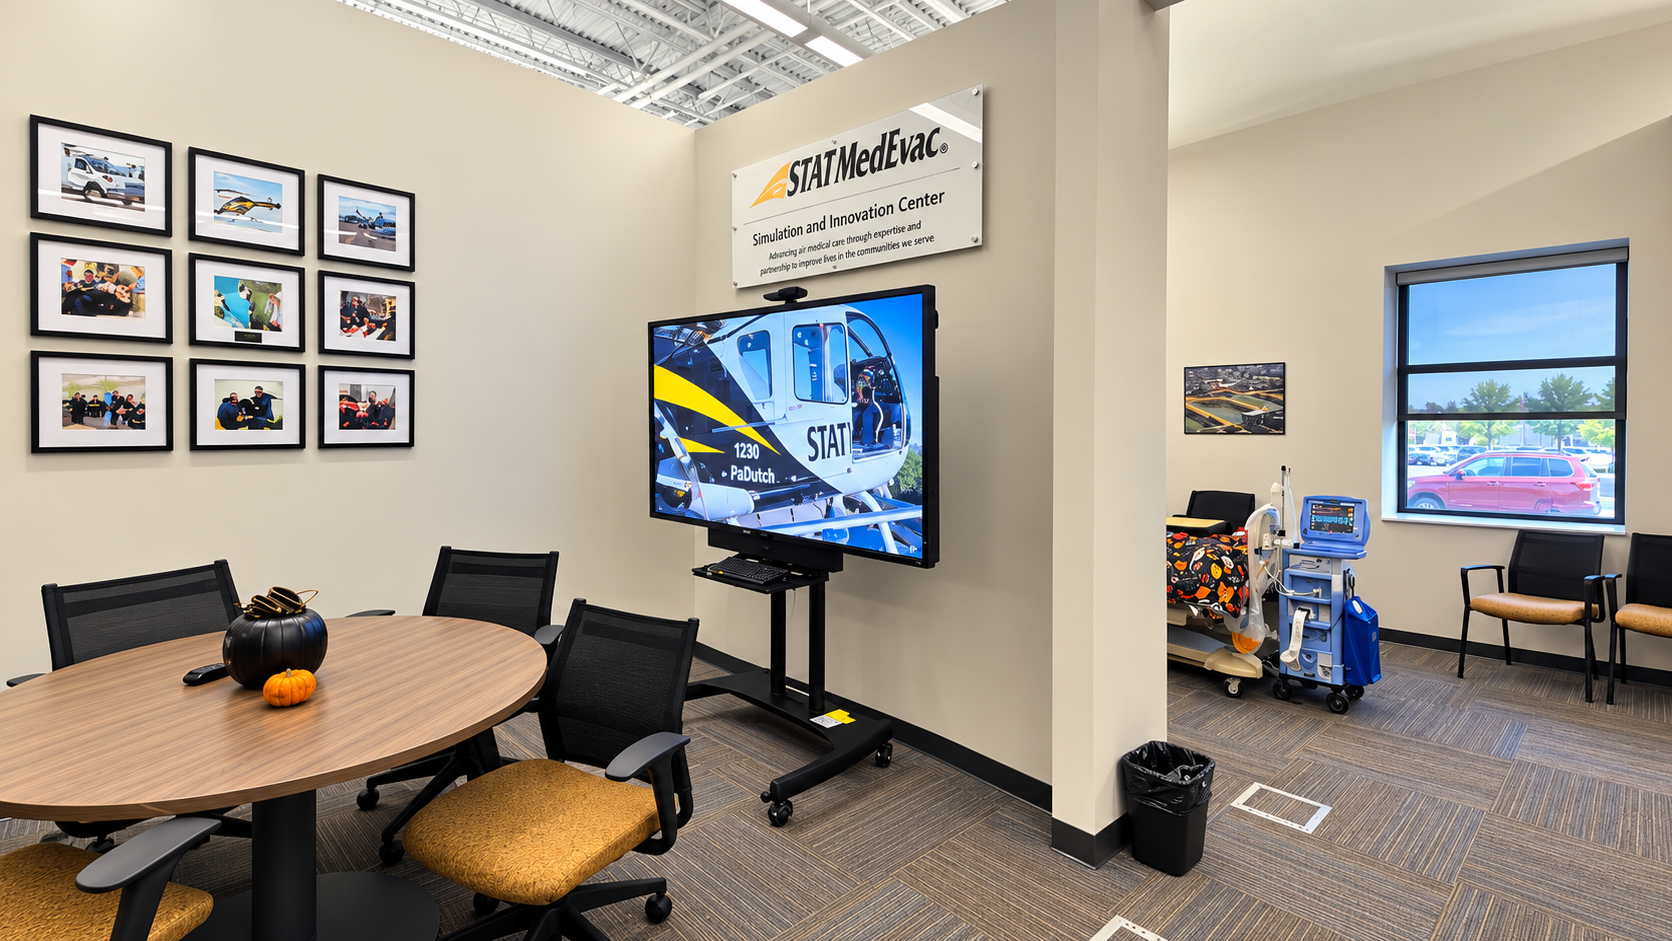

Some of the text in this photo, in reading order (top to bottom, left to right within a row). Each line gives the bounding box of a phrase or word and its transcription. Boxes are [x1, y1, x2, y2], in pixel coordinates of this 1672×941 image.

[753, 191, 945, 246] Simulation and Innovation Center
[760, 263, 791, 277] partnership
[791, 261, 798, 270] to
[798, 256, 823, 269] improve
[823, 254, 837, 264] lives
[837, 251, 845, 261] in
[845, 249, 856, 260] the
[856, 241, 901, 257] communities
[901, 239, 913, 248] we
[768, 220, 922, 261] Advancing air medical care through expertise and
[734, 442, 760, 460] 1230
[807, 422, 852, 461] STAT
[730, 465, 775, 484] PaDutch
